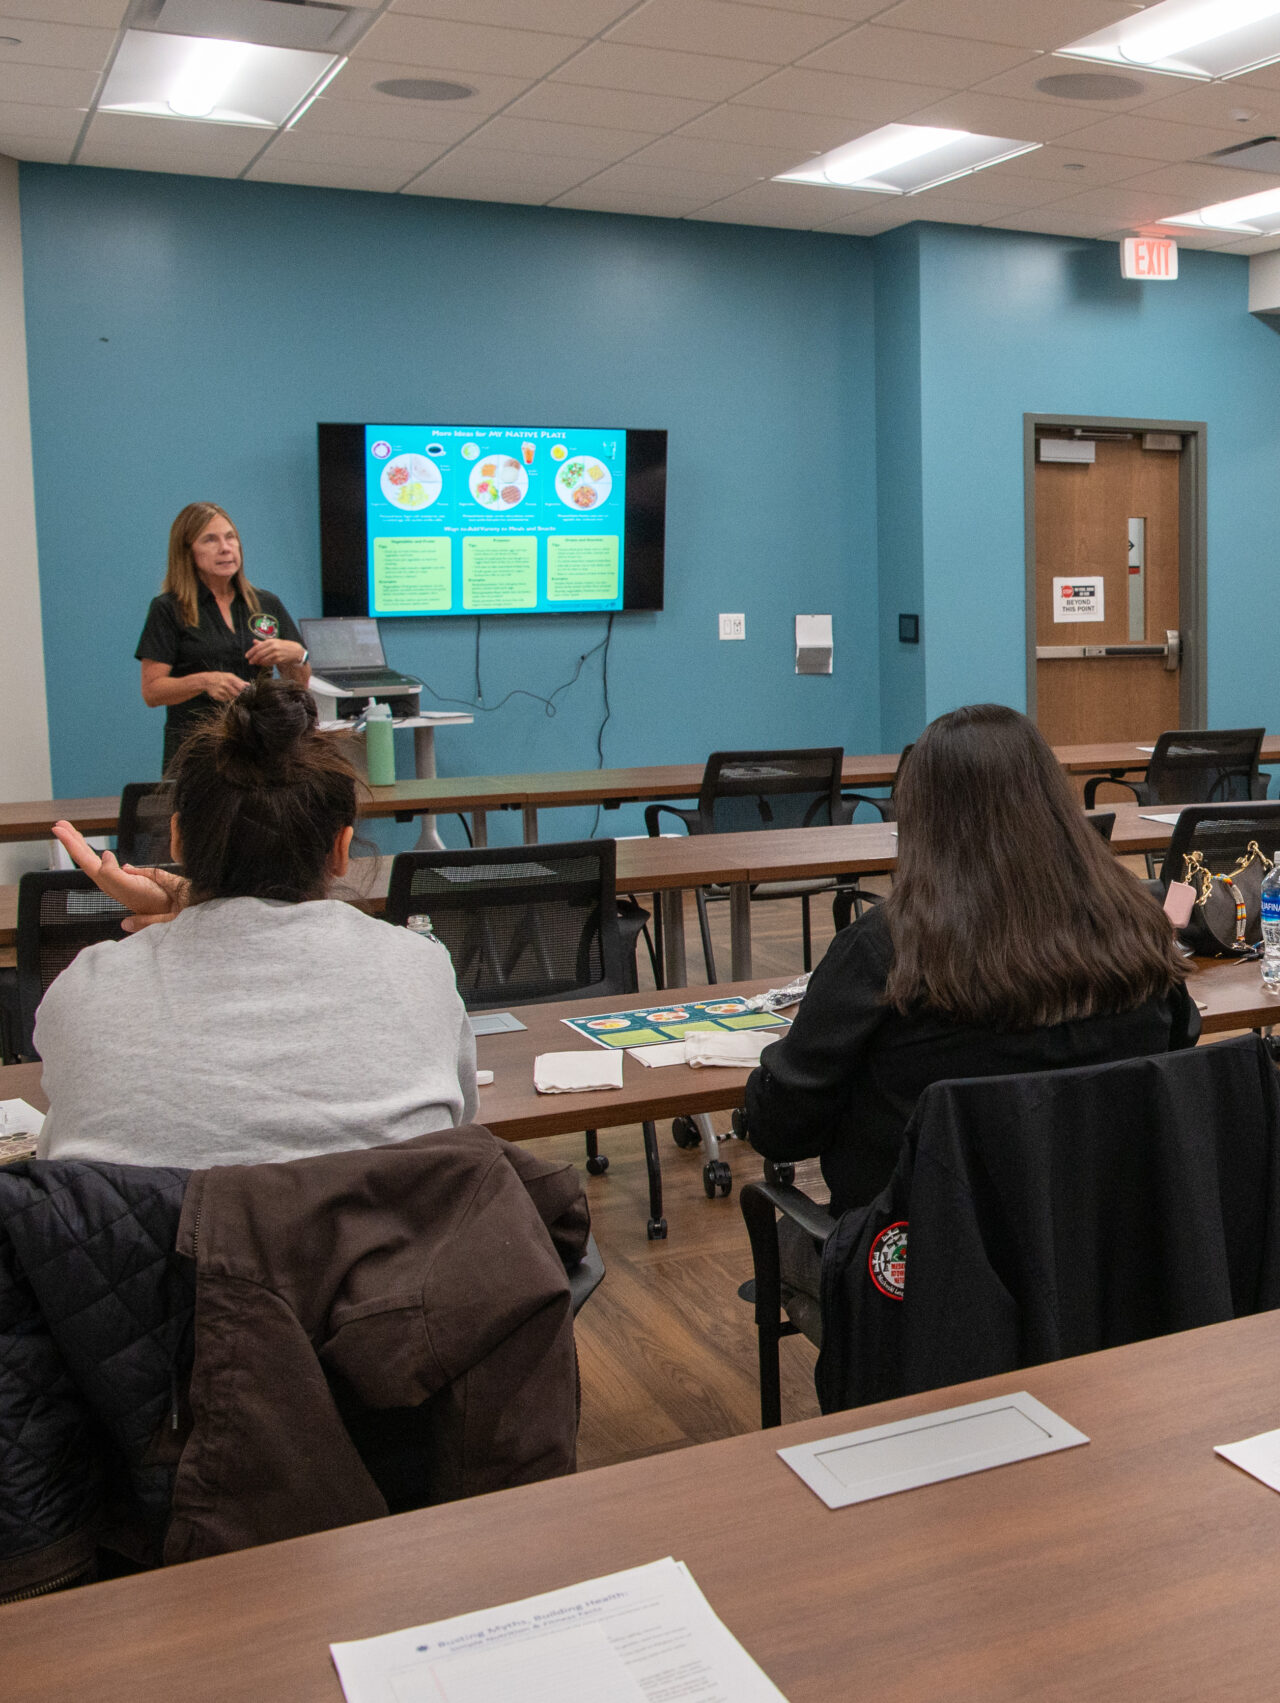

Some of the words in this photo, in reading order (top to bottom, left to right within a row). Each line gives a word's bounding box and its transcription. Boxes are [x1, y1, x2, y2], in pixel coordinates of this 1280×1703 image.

[1134, 240, 1172, 276] EXIT
[541, 431, 566, 439] PLATE
[438, 1630, 485, 1649] Busting
[487, 1618, 532, 1635] Myths,
[533, 1603, 584, 1622] Building
